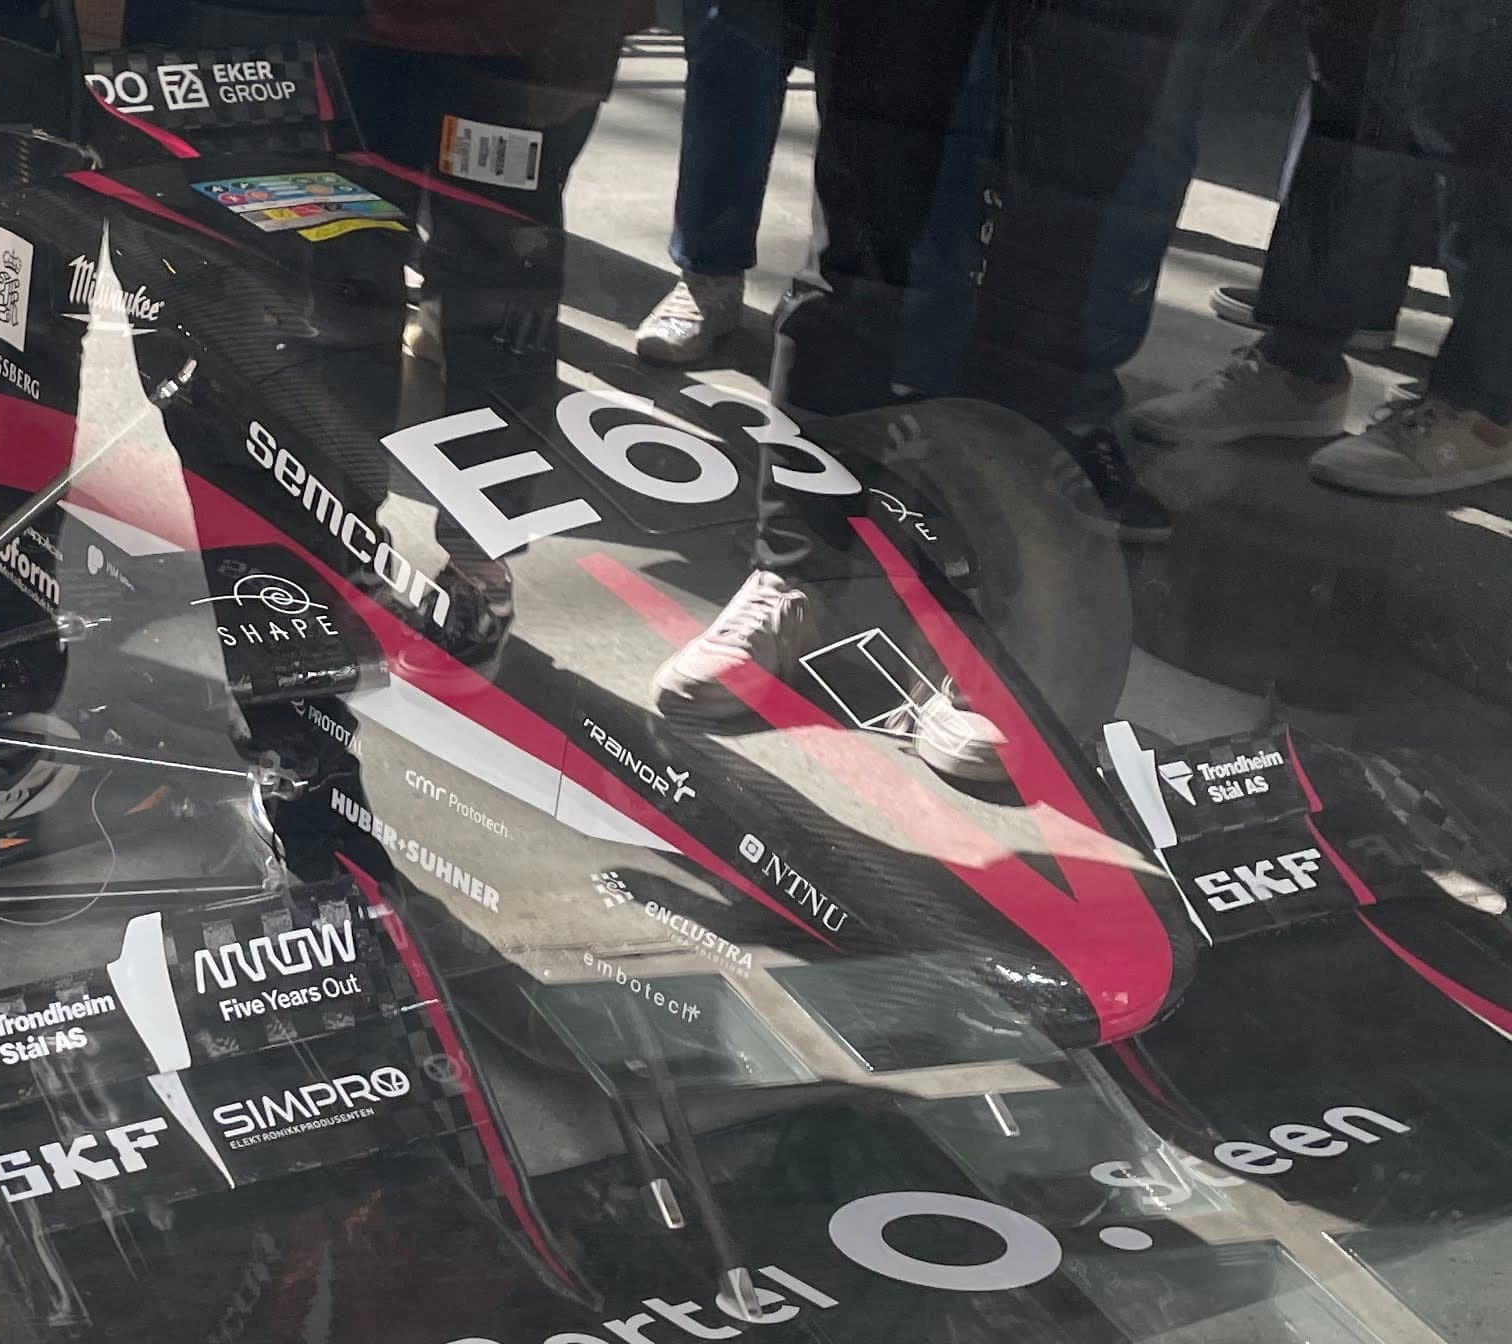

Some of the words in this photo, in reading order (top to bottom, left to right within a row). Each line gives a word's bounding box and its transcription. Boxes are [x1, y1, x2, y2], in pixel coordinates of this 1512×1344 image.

[85, 72, 149, 104] DO
[213, 61, 274, 84] EKER
[219, 80, 296, 105] GROUP
[380, 407, 602, 561] E
[555, 383, 863, 504] 63
[245, 420, 451, 629] semcon
[217, 614, 340, 646] SHAPE
[308, 705, 363, 754] PROTOTAL
[1197, 749, 1284, 783] Trondheim
[1207, 779, 1243, 804] Stål
[1242, 774, 1269, 796] AS
[405, 769, 447, 801] cmr
[448, 792, 508, 839] Prototech
[330, 786, 501, 914] HUBER+SUHNER
[761, 852, 849, 935] NTNU
[1194, 847, 1322, 913] SKF
[220, 996, 265, 1023] Five
[262, 985, 322, 1013] Years
[321, 974, 362, 1001] Out
[0, 1034, 49, 1065] Stål
[55, 1026, 89, 1053] AS
[213, 1066, 411, 1139] SIMPRO
[229, 1107, 376, 1150] ELEKTRONIKKPRODUSENTEN
[1090, 1103, 1412, 1208] Steen
